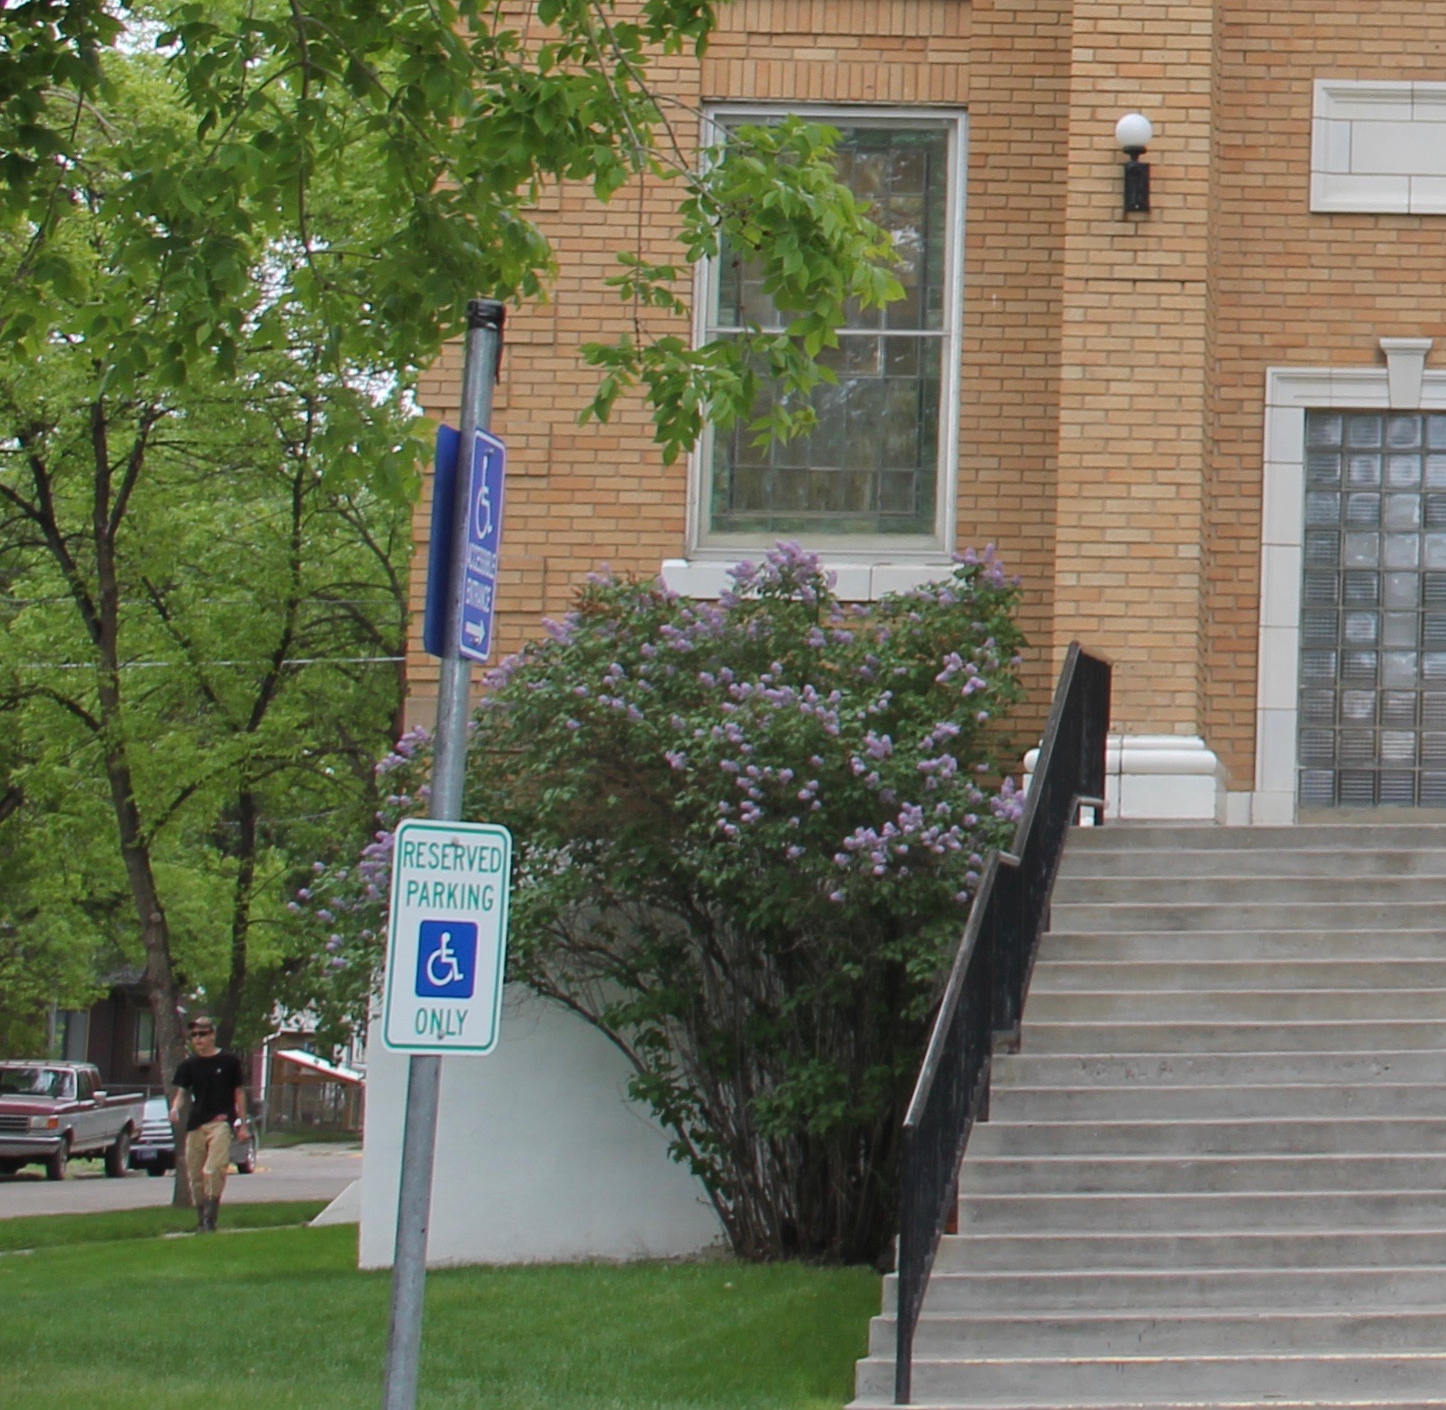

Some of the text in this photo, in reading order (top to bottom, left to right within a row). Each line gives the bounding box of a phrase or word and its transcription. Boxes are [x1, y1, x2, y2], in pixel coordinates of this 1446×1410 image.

[403, 841, 502, 873] RESERVED
[406, 880, 494, 911] PARKING
[415, 1007, 468, 1036] ONLY
